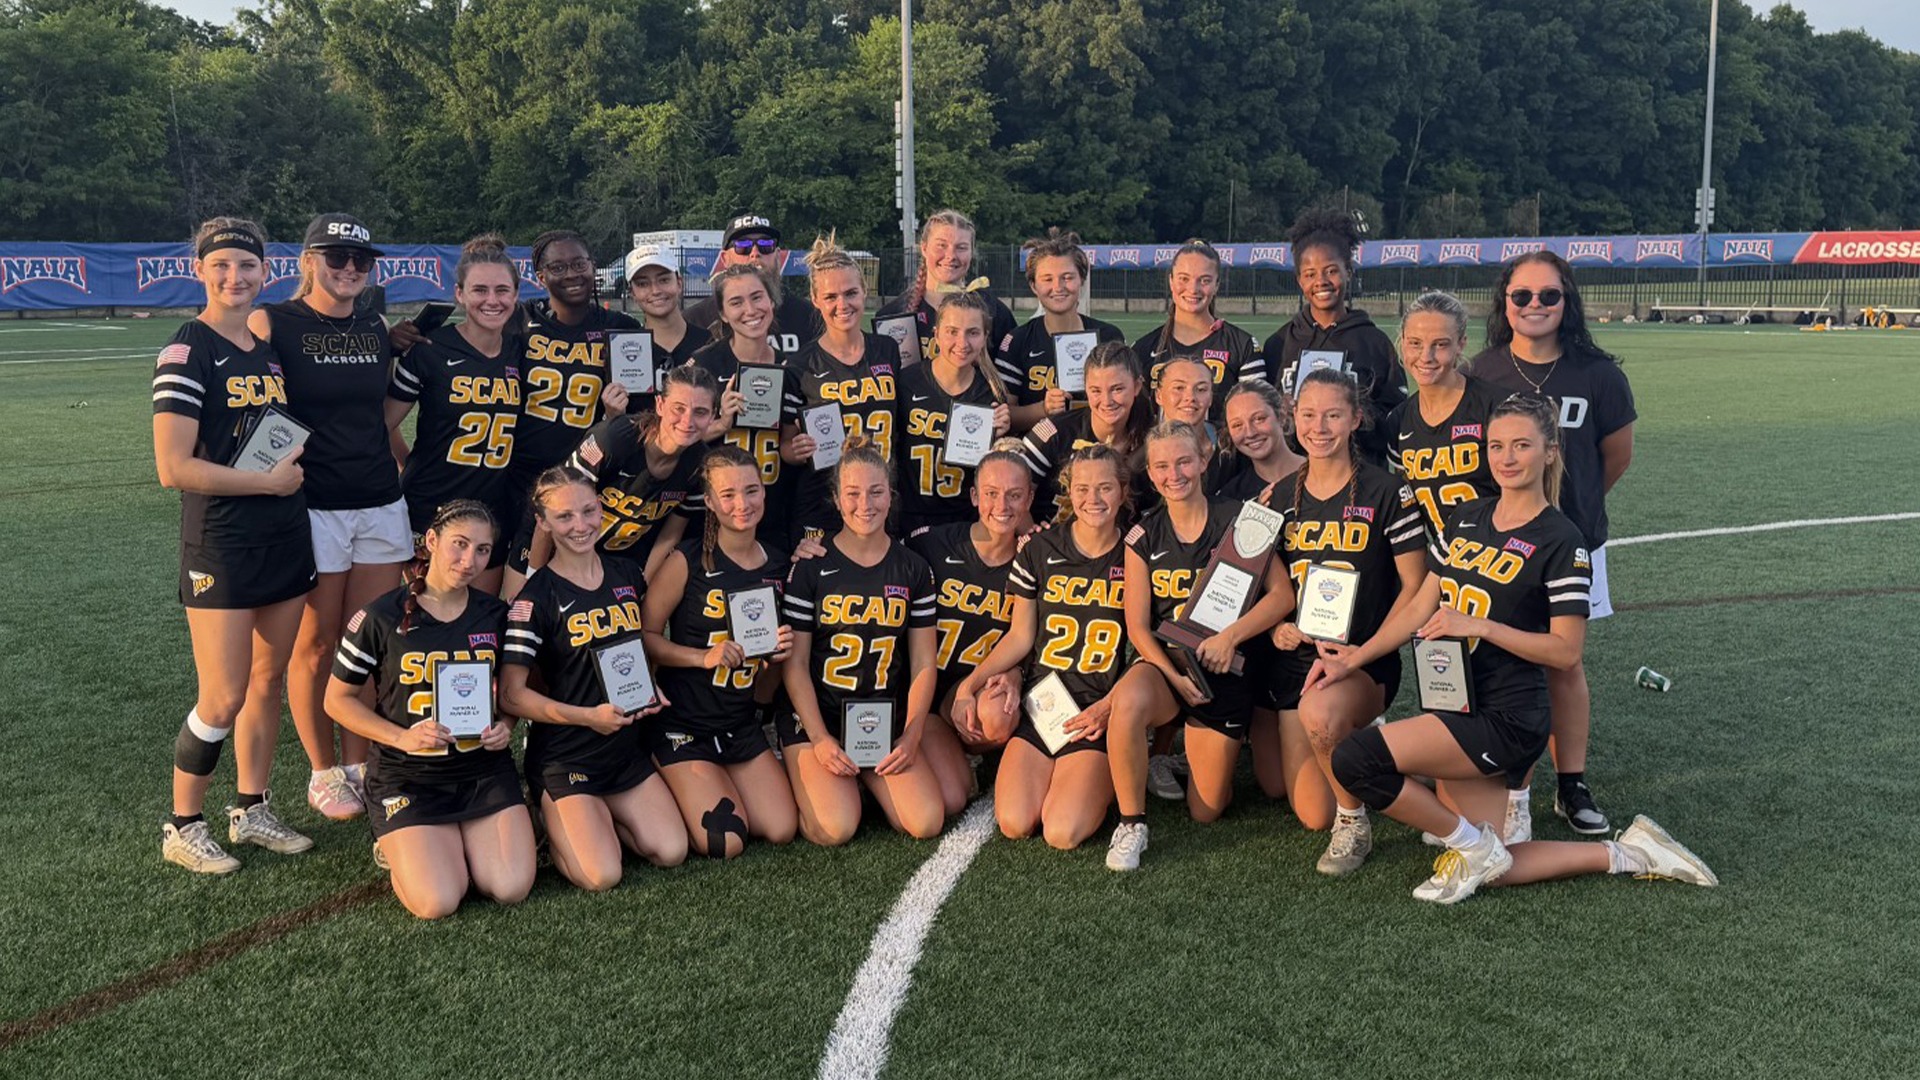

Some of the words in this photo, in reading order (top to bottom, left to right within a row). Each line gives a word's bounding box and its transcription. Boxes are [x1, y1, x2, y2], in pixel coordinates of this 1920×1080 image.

[327, 222, 370, 241] SCAD
[734, 216, 770, 229] SCAD
[1250, 247, 1285, 267] NAIA
[1380, 244, 1420, 264] NAIA
[1439, 243, 1480, 264] NAIA
[1567, 242, 1612, 263] NAIA
[1637, 240, 1683, 262] NAIA
[1724, 240, 1773, 262] NAIA
[1818, 242, 1920, 258] LACROSSE
[2, 257, 87, 292] NAIA
[138, 257, 197, 291] NAI
[264, 257, 302, 287] NA
[377, 257, 441, 289] NAIA
[303, 333, 380, 355] SCAD
[314, 355, 379, 364] LACROSSE
[449, 377, 521, 404] SCAD
[525, 366, 604, 429] 29
[820, 376, 896, 405] SCAD
[908, 408, 948, 438] SC
[1451, 424, 1482, 440] NAIA
[446, 411, 517, 469] 25
[910, 444, 965, 498] 15
[1402, 442, 1480, 481] SCAD
[600, 487, 681, 521] SCAD
[1344, 506, 1374, 522] NAIA
[1284, 521, 1369, 551] SCAD
[1503, 537, 1536, 560] NAIA
[1446, 537, 1525, 585] SCAD
[1043, 574, 1125, 609] SCAD
[1152, 568, 1202, 599] SC
[820, 594, 907, 626] SCAD
[937, 578, 1016, 623] SCAD
[568, 602, 642, 647] SCAD
[468, 633, 499, 648] NAIA
[1040, 613, 1122, 674] 28
[823, 633, 897, 691] 21
